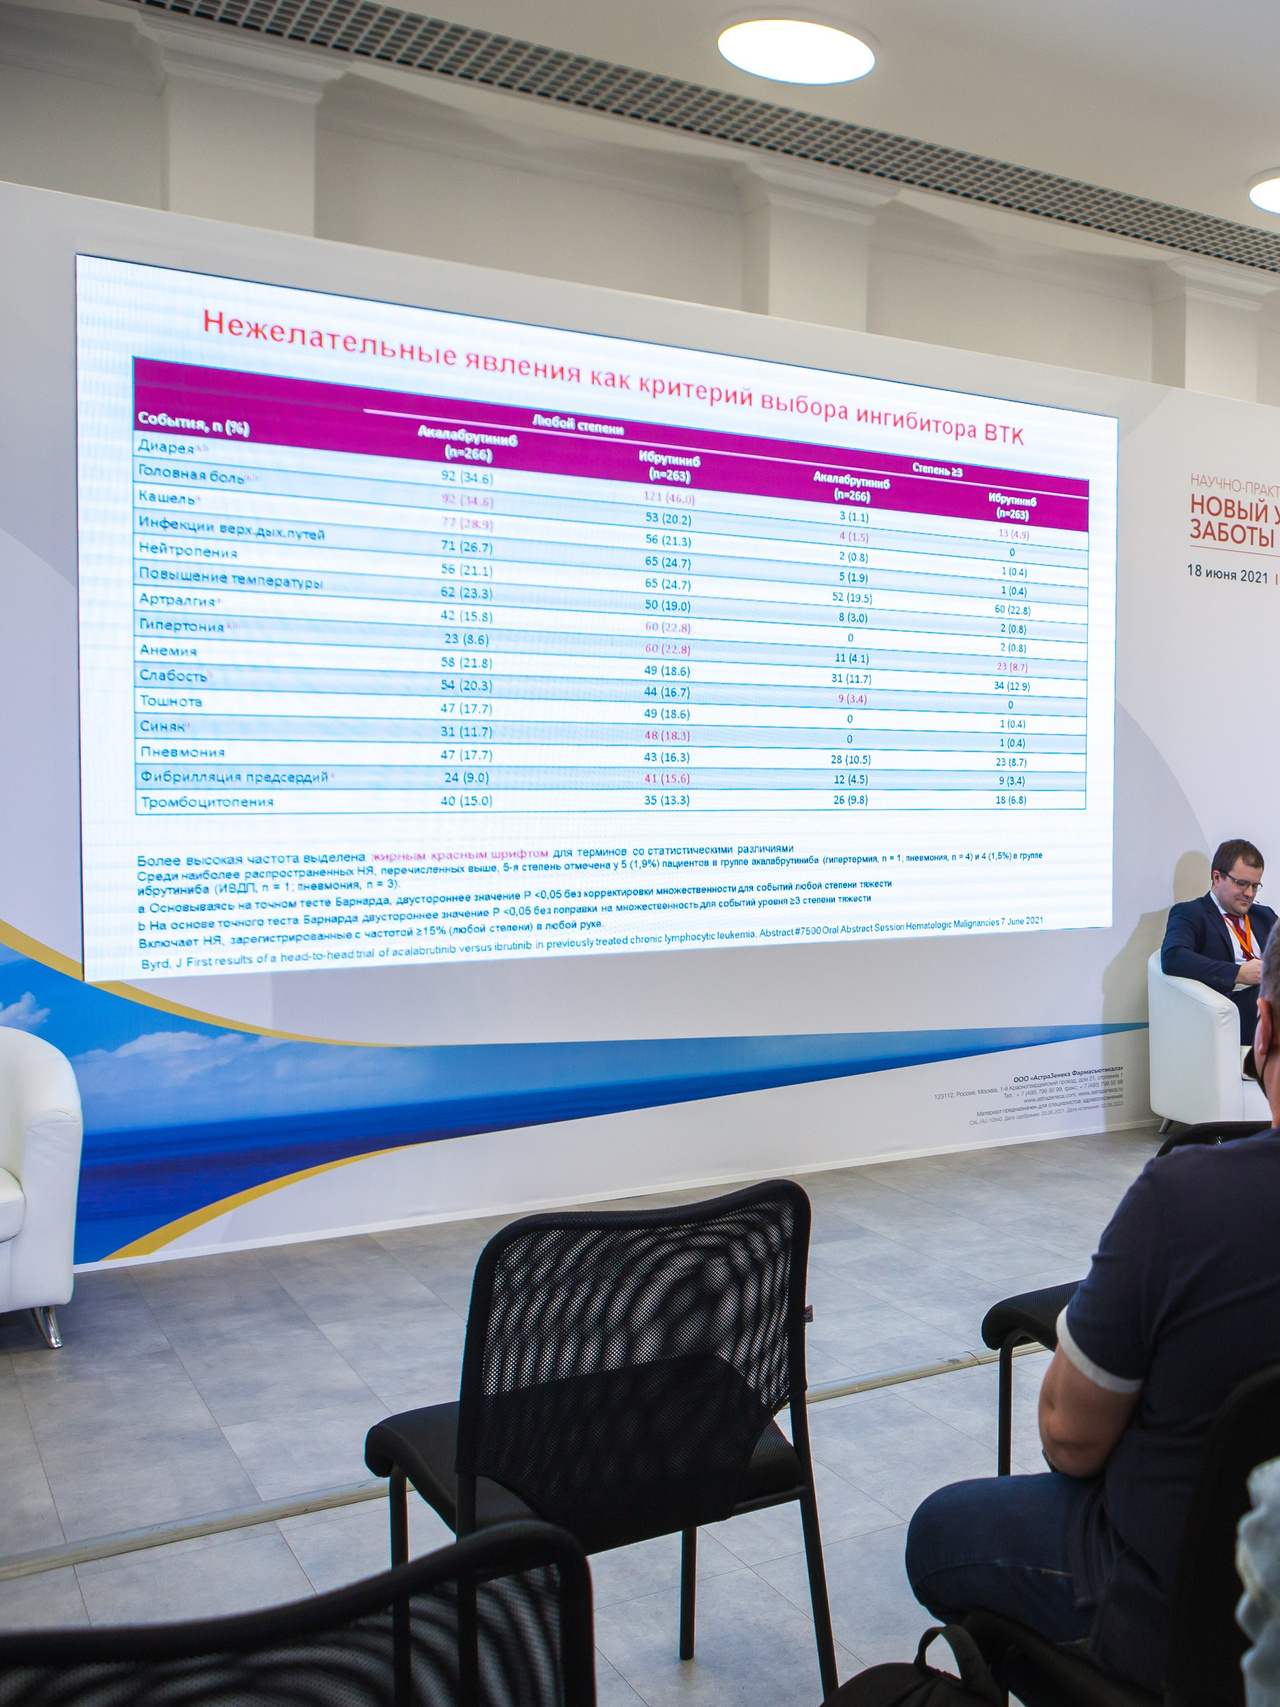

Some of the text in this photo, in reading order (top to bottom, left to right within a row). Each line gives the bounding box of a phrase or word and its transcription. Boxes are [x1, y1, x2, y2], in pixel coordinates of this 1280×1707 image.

[204, 309, 456, 365] Нежелательные
[466, 353, 580, 382] явления
[591, 370, 629, 389] как
[640, 377, 752, 406] критерий
[761, 394, 847, 422] выбора
[857, 408, 976, 440] ингибитора
[138, 411, 250, 438] События, n (%)
[532, 413, 624, 435] Любой степени
[417, 424, 518, 447] Акалабрутиниб
[445, 443, 492, 464] (n=266)
[639, 450, 700, 467] Ибрутиниб
[138, 463, 206, 480] Головная
[649, 466, 691, 484] (n=263)
[912, 462, 963, 477] Степень ≥3
[441, 469, 493, 485] 92 (34.6)
[813, 470, 890, 489] Акалабрутиниб
[834, 487, 871, 504] (n=266)
[988, 492, 1037, 507] Ибрутиниб
[996, 506, 1029, 522] (n=263)
[1191, 493, 1267, 524] НОВЫЙ
[139, 515, 213, 533] Инфекции
[645, 511, 691, 527] 53 (20.2)
[840, 510, 869, 524] 3 (1.1)
[1190, 518, 1274, 548] ЗАБОТЫ
[441, 539, 492, 555] 71 (26.7)
[646, 533, 691, 548] 56 (21.3)
[139, 541, 237, 557] Нейтропения
[441, 563, 492, 576] 56 (21.1)
[1188, 564, 1201, 577] 18
[1206, 568, 1236, 581] июня
[1241, 570, 1268, 584] 2021
[139, 566, 322, 589] Повышение температуры
[839, 571, 868, 583] 5 (1.9)
[645, 578, 691, 591] 65 (24.7)
[832, 591, 872, 605] 52 (19.5)
[838, 611, 868, 623] 8 (3.0)
[994, 604, 1030, 616] 60 (22.8)
[1000, 623, 1026, 635] 2 (0.8)
[140, 644, 197, 656] Анемия
[835, 652, 869, 665] 11 (4.1)
[644, 665, 690, 678] 49 (18.6)
[831, 673, 871, 685] 31 (11.7)
[994, 680, 1030, 692] 34 (12.9)
[140, 694, 202, 707] Тошнота
[440, 702, 492, 715] 47 (17.7)
[1000, 719, 1025, 729] 1 (0.4)
[141, 745, 224, 757] Пневмония
[440, 749, 492, 762] 47 (17.7)
[644, 751, 689, 764] 43 (16.3)
[831, 754, 871, 766] 28 (10.5)
[996, 757, 1027, 767] 23 (8.7)
[140, 770, 241, 784] Фибрилляция
[834, 773, 868, 785] 12 (4.5)
[141, 796, 273, 809] Тромбоцитопения
[440, 795, 492, 808] 40 (15.0)
[644, 794, 690, 806] 35 (13.3)
[833, 794, 868, 806] 26 (9.8)
[996, 795, 1026, 805] 18 (6.8)
[137, 845, 793, 866] Более высокая частота выделена терминов статистическими различиями
[137, 855, 818, 883] Среди распространенных отмечена пациентов акалабрутиниба
[137, 884, 209, 896] ибрутиниба
[149, 902, 234, 913] Основываясь
[300, 899, 331, 907] тесте
[395, 894, 471, 906] двустороннее
[583, 888, 653, 898] корректировки
[656, 885, 736, 894] множественности
[756, 882, 792, 891] событий
[859, 880, 892, 888] тяжести
[303, 898, 787, 926] Барнарда поправки событий уровня
[138, 931, 352, 948] Включает зарегистрированные
[392, 917, 1024, 956] acalabrutinib versus treated chronic lymphocytic leukemia. Abstract Session Hematologic Malignancies June
